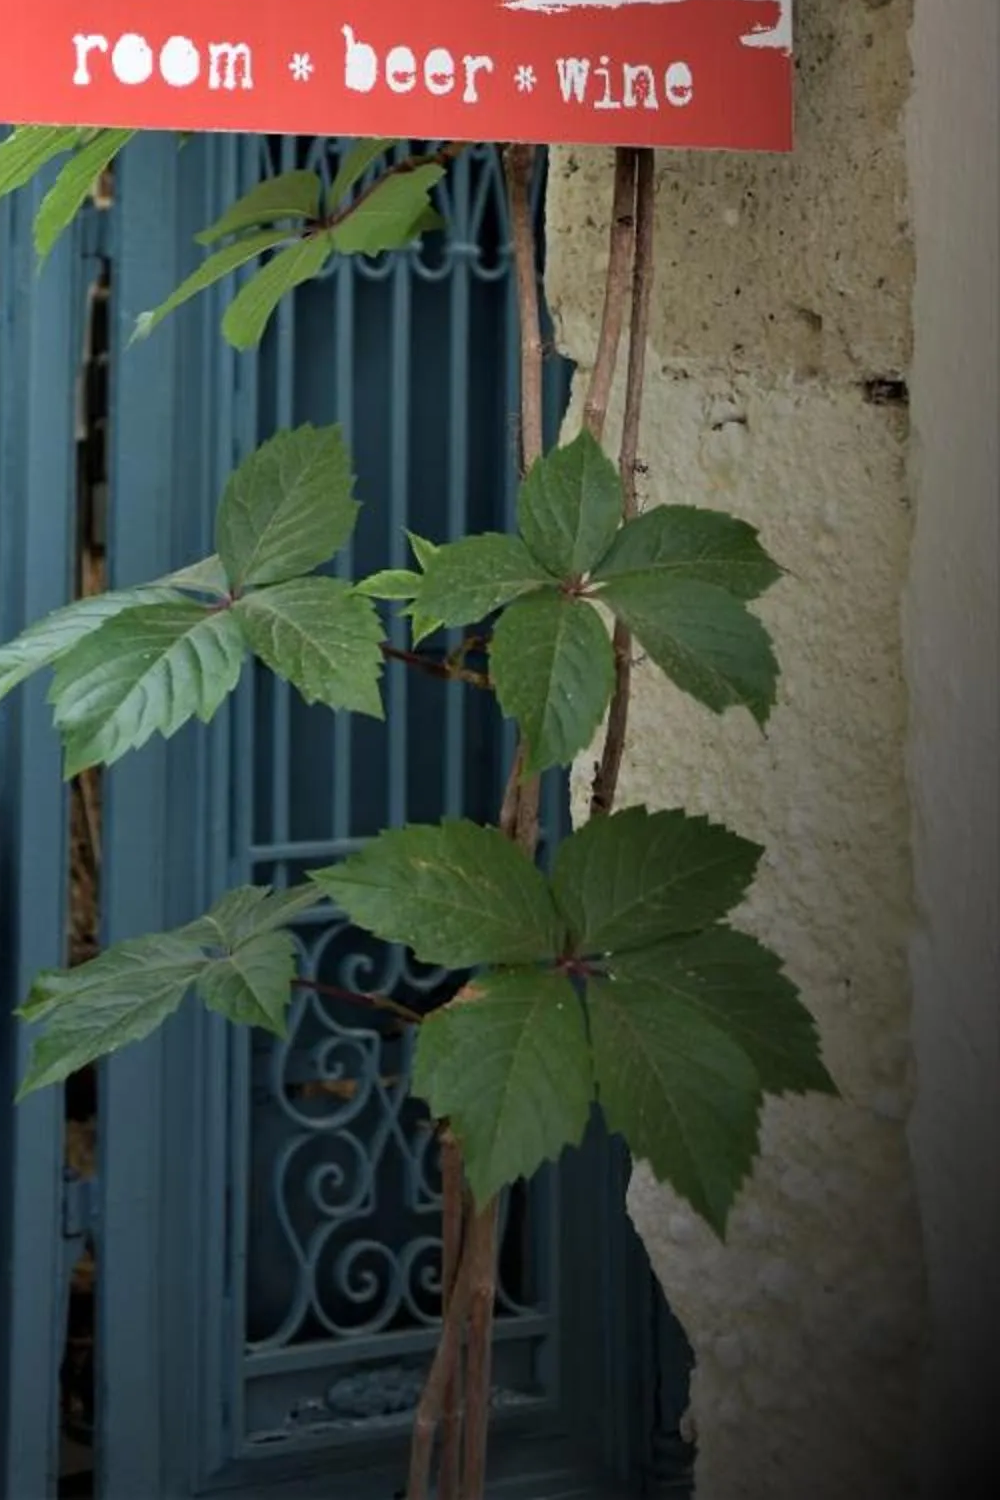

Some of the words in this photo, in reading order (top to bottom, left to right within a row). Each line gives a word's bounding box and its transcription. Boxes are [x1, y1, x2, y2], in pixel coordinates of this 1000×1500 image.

[72, 31, 253, 92] room
[341, 24, 493, 103] beer
[556, 55, 694, 109] wine
